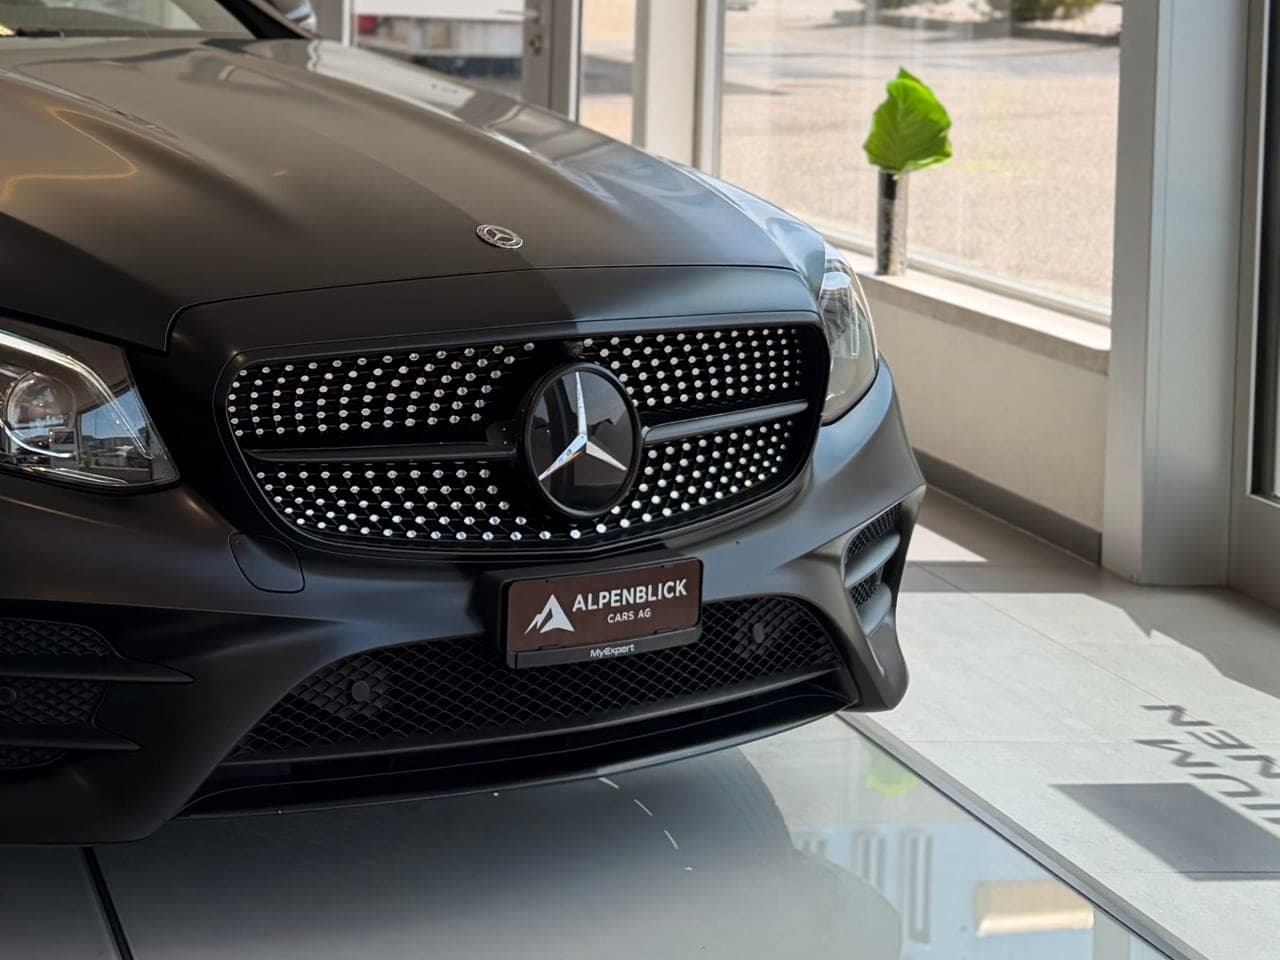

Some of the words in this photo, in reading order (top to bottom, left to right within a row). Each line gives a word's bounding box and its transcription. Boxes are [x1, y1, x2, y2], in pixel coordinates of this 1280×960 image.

[572, 578, 687, 613] ALPENBLICK
[607, 610, 635, 624] CARS
[637, 607, 652, 619] AG
[589, 643, 635, 658] MyExpert
